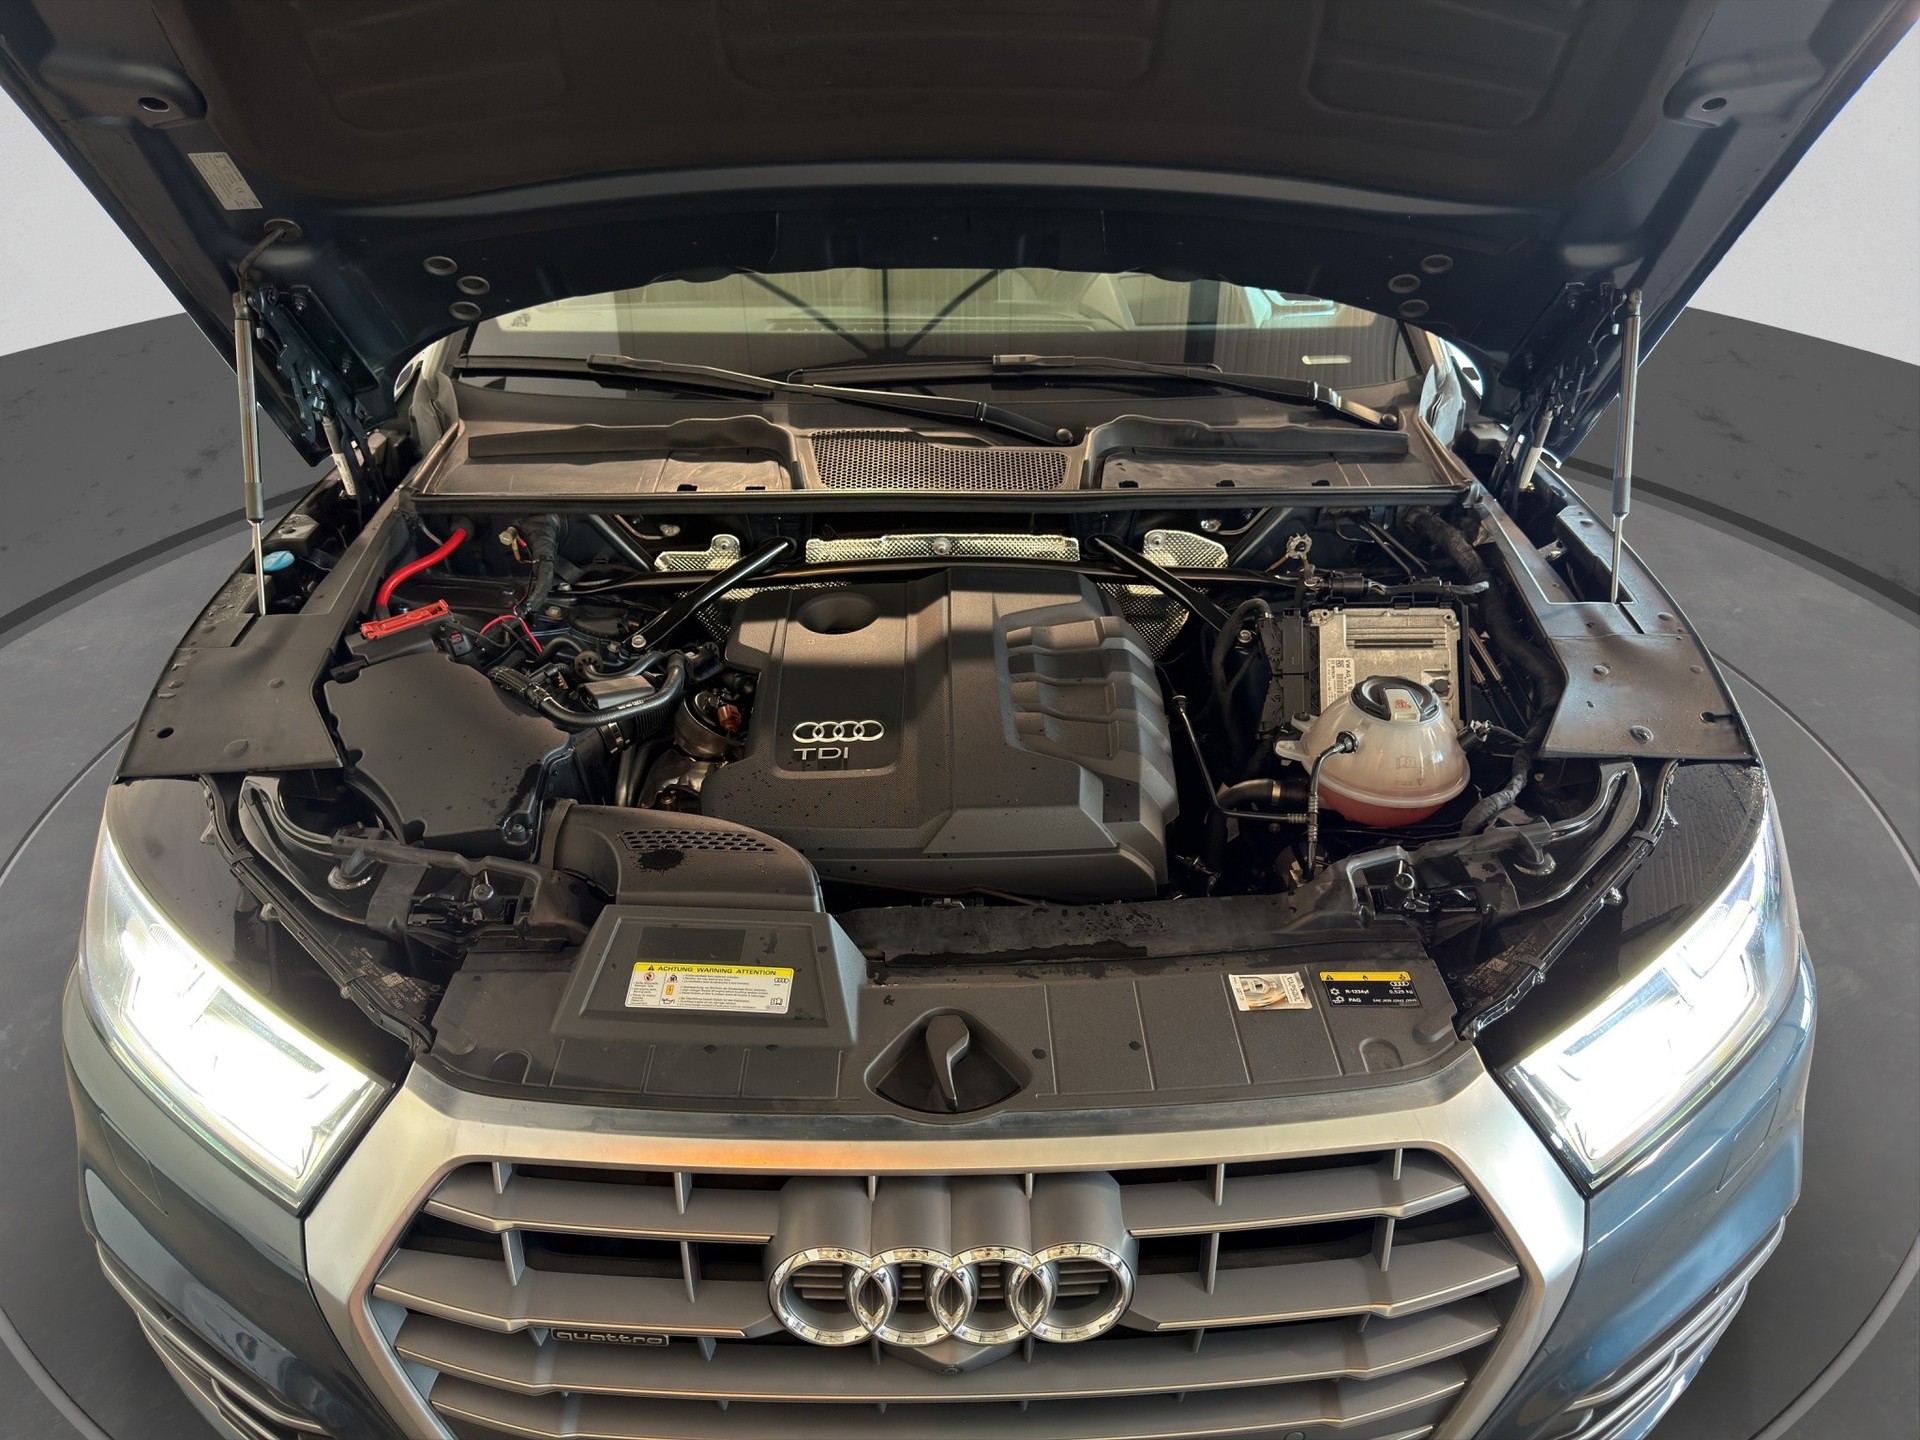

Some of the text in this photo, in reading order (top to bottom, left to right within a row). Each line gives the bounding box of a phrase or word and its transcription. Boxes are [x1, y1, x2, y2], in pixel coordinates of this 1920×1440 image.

[793, 746, 849, 760] TDI
[657, 965, 694, 973] ACHTUNG
[736, 968, 777, 976] ATTENTION
[557, 1332, 663, 1344] quattro
